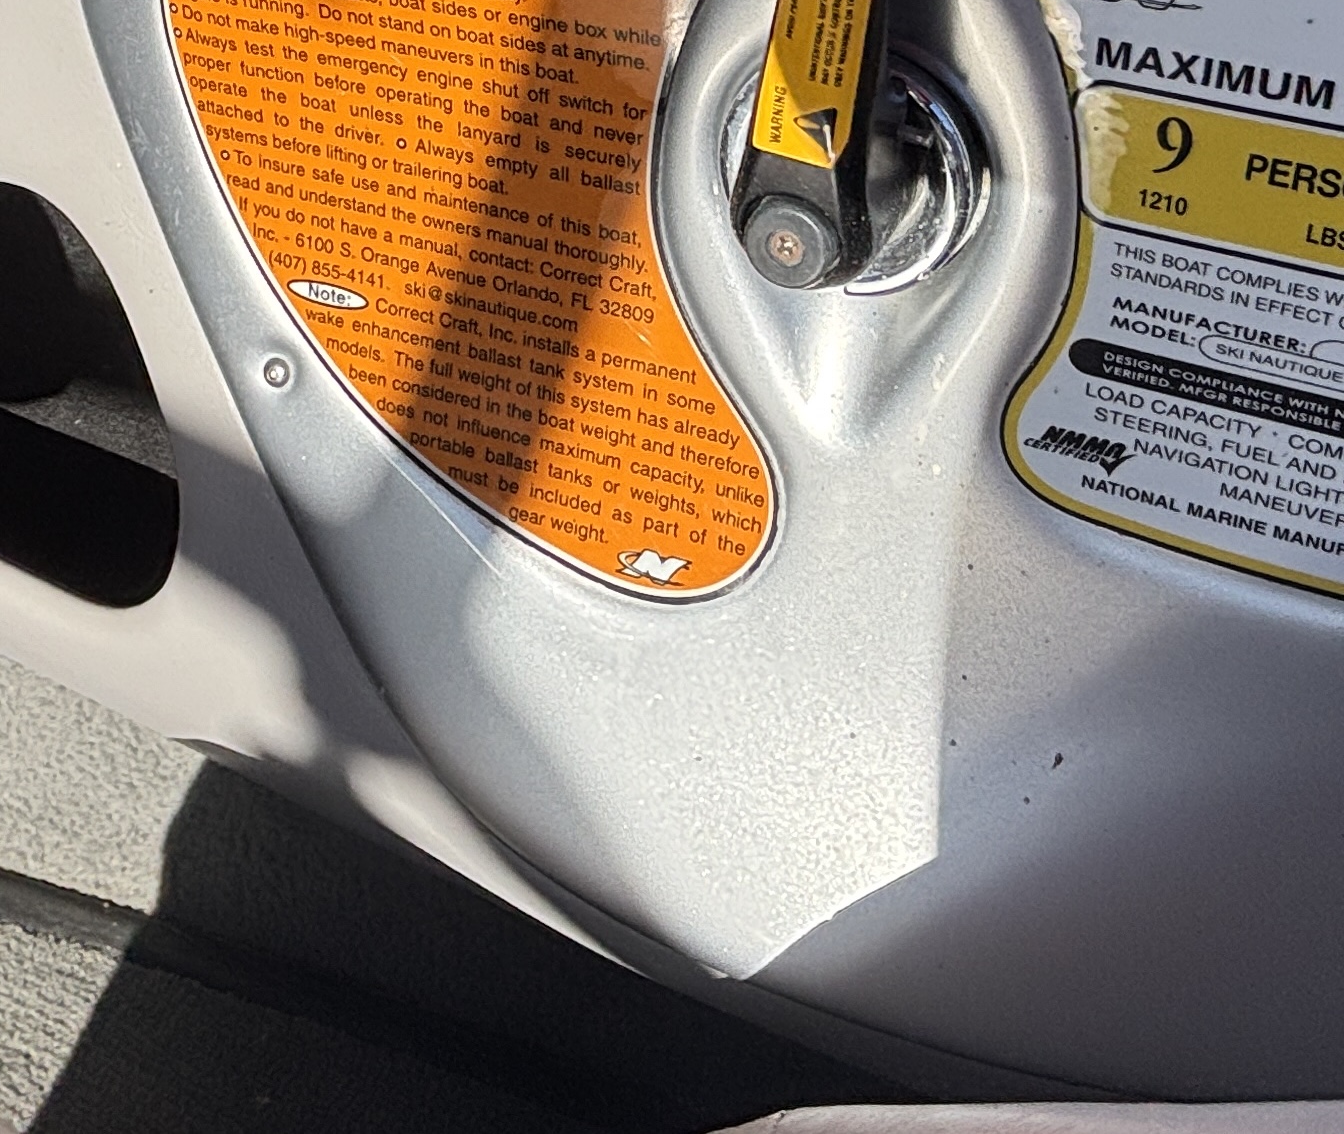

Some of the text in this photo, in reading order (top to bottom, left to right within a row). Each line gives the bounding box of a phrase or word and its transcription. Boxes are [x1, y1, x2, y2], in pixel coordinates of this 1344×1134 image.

[318, 2, 342, 21] Do
[346, 11, 373, 26] not
[378, 15, 424, 34] stand
[429, 24, 451, 39] on
[456, 24, 494, 45] boat
[499, 33, 546, 55] sides
[551, 41, 569, 57] at
[1095, 37, 1335, 110] MAXIMUM
[769, 85, 787, 144] WARNING
[1152, 115, 1194, 174] 9
[1138, 188, 1188, 217] 1210
[268, 249, 306, 275] (407)
[404, 280, 577, 332] ski@skinautique.com
[295, 232, 334, 254] 6100
[360, 246, 419, 274] Orange
[425, 260, 486, 287] Avenue
[570, 291, 594, 313] FL
[598, 298, 654, 323] 32809
[308, 282, 351, 307] Note:
[1110, 262, 1224, 301] STANDARDS
[1230, 290, 1249, 307] IN
[1254, 296, 1334, 325] EFFECT
[1114, 241, 1155, 264] THIS
[1161, 253, 1212, 276] BOAT
[1216, 266, 1320, 302] COMPLIES
[375, 297, 434, 325] Correct
[522, 330, 579, 360] installs
[584, 348, 596, 362] a
[600, 352, 696, 385] permanent
[1110, 315, 1195, 347] MODEL:
[1113, 296, 1306, 353] MANUFACTURER:
[1103, 351, 1163, 373] DESIGN
[1168, 368, 1282, 403] COMPLIANCE
[1288, 397, 1328, 414] WITH
[1215, 343, 1244, 359] SKI
[1248, 351, 1343, 383] NAUTIQUE
[1085, 382, 1144, 408] LOAD
[1150, 399, 1261, 437] CAPACITY
[1178, 383, 1227, 402] MFGR
[1232, 395, 1341, 431] RESPONSIBLE
[1023, 437, 1100, 463] CERTIFIED
[1093, 406, 1212, 451] STEERING,
[1220, 438, 1279, 466] FUEL
[1285, 456, 1336, 480] AND
[1133, 438, 1268, 485] NAVIGATION
[448, 464, 745, 556] must be included as part of the
[509, 507, 545, 529] gear
[1081, 474, 1180, 512] NATIONAL
[1186, 502, 1267, 535] MARINE
